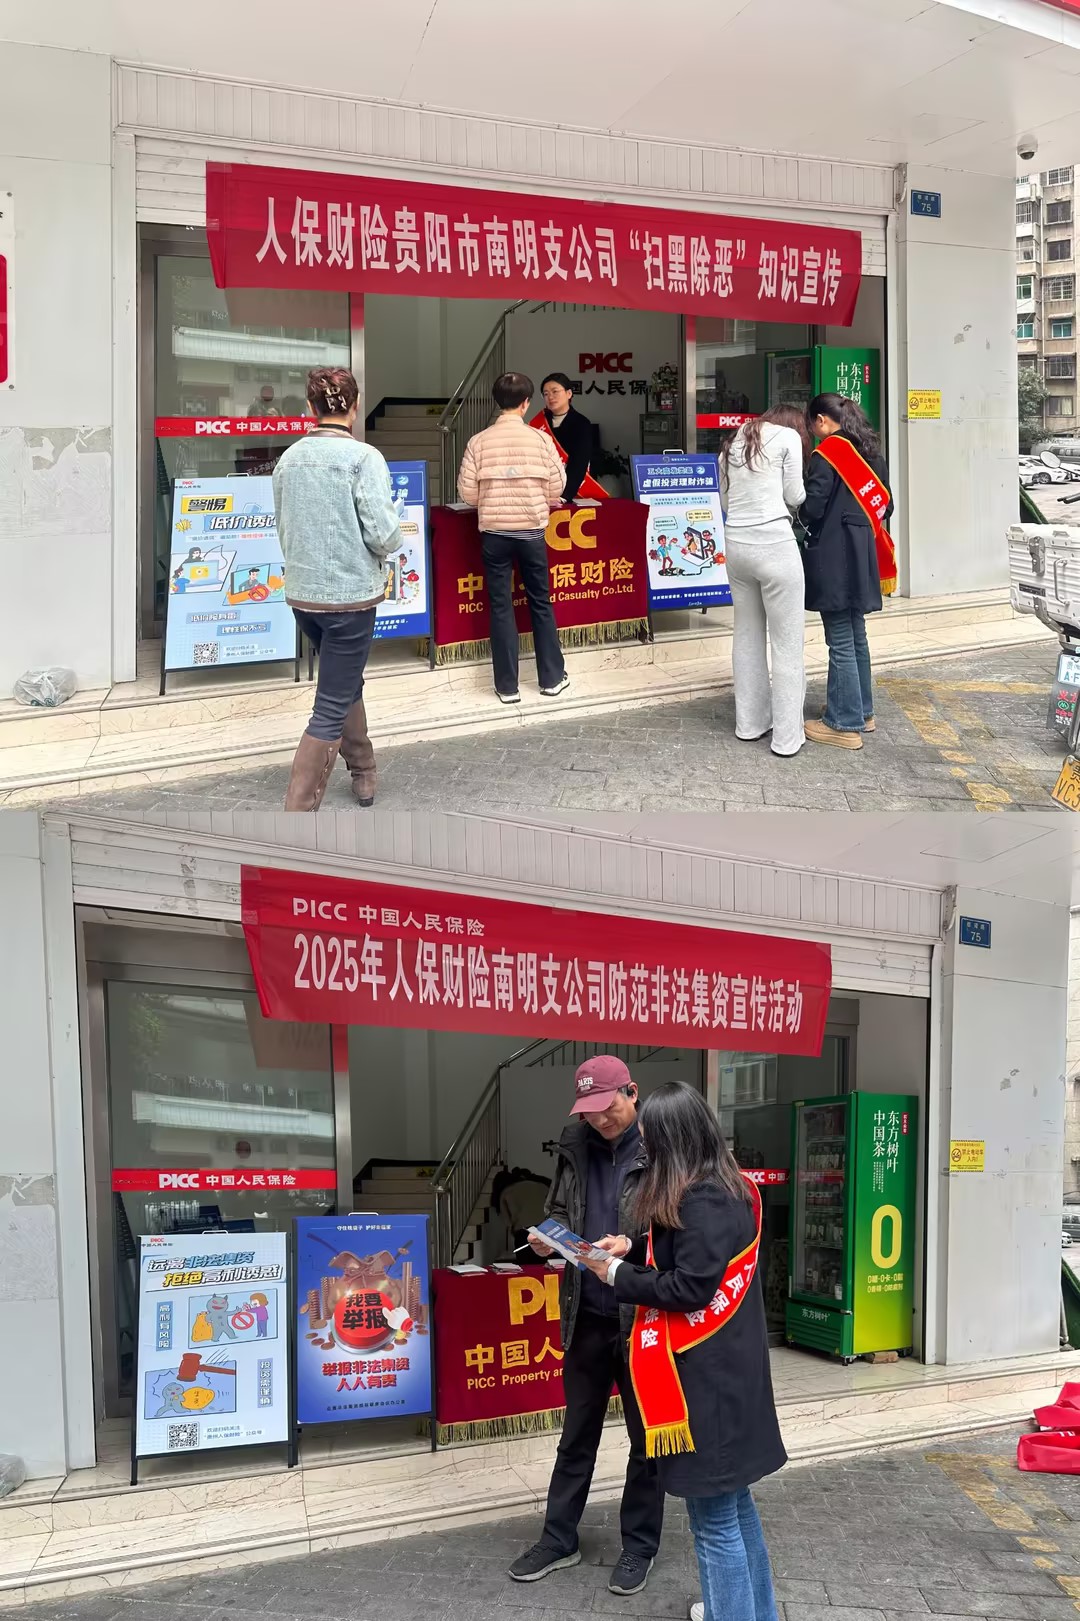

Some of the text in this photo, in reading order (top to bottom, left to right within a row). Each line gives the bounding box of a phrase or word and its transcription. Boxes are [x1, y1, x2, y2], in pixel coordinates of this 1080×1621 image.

[921, 203, 932, 212] 75
[579, 353, 633, 373] PICC
[570, 381, 650, 395] 国人民保
[850, 362, 861, 405] 东方树
[195, 420, 316, 434] PICC 中国人民保险
[719, 416, 741, 426] PICC
[643, 477, 713, 487] 虚假投资理财诈骗
[859, 480, 876, 496] PICC
[188, 498, 227, 511] 警惕
[545, 508, 597, 551] CC
[458, 557, 635, 600] 中保财险
[459, 602, 484, 613] PICC
[558, 589, 600, 602] Casualty
[292, 897, 485, 937] PICC 中国人民保险
[970, 931, 981, 942] 75
[294, 933, 803, 1034] 2025年人保财险南明支公司防范非法集资宣传活动
[872, 1109, 886, 1158] 中国茶
[886, 1110, 900, 1174] 东方树叶
[159, 1174, 296, 1188] PICC 中国人民保险
[768, 1173, 786, 1181] 中国
[871, 1204, 903, 1269] 0
[147, 1252, 255, 1272] 远离非法集资
[162, 1264, 280, 1287] 拒绝高利诱惑
[345, 1292, 382, 1308] 我要
[508, 1274, 561, 1325] PI
[342, 1308, 388, 1330] 举报
[464, 1336, 565, 1374] 中国人
[322, 1357, 410, 1377] 举报非法集资
[336, 1375, 397, 1391] 人人有责
[467, 1376, 496, 1390] PICC
[502, 1370, 550, 1385] Property
